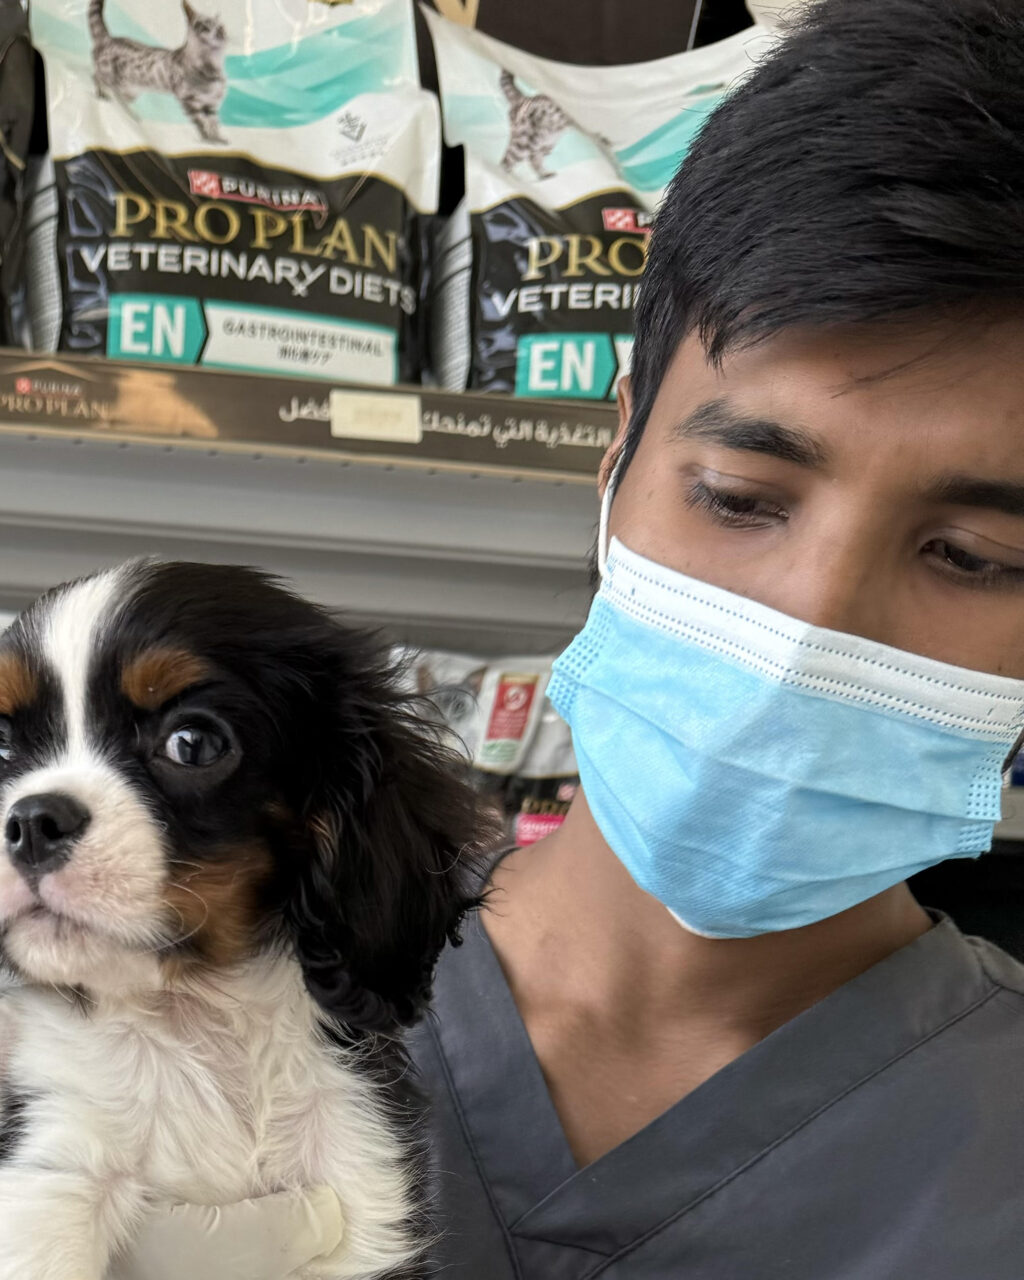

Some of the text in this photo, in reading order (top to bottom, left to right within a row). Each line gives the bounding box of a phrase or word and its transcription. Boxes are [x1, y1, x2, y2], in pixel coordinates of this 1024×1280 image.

[221, 177, 321, 207] PURINA
[109, 192, 398, 273] PRO PLAN
[80, 241, 417, 315] VETERINARY DIETS
[521, 233, 650, 281] PRO
[492, 282, 640, 317] VETERI
[119, 302, 187, 357] EN
[222, 317, 384, 357] GASTROINTESTINAL
[528, 340, 596, 392] EN
[46, 394, 110, 421] PLAN
[493, 419, 531, 448] التي
